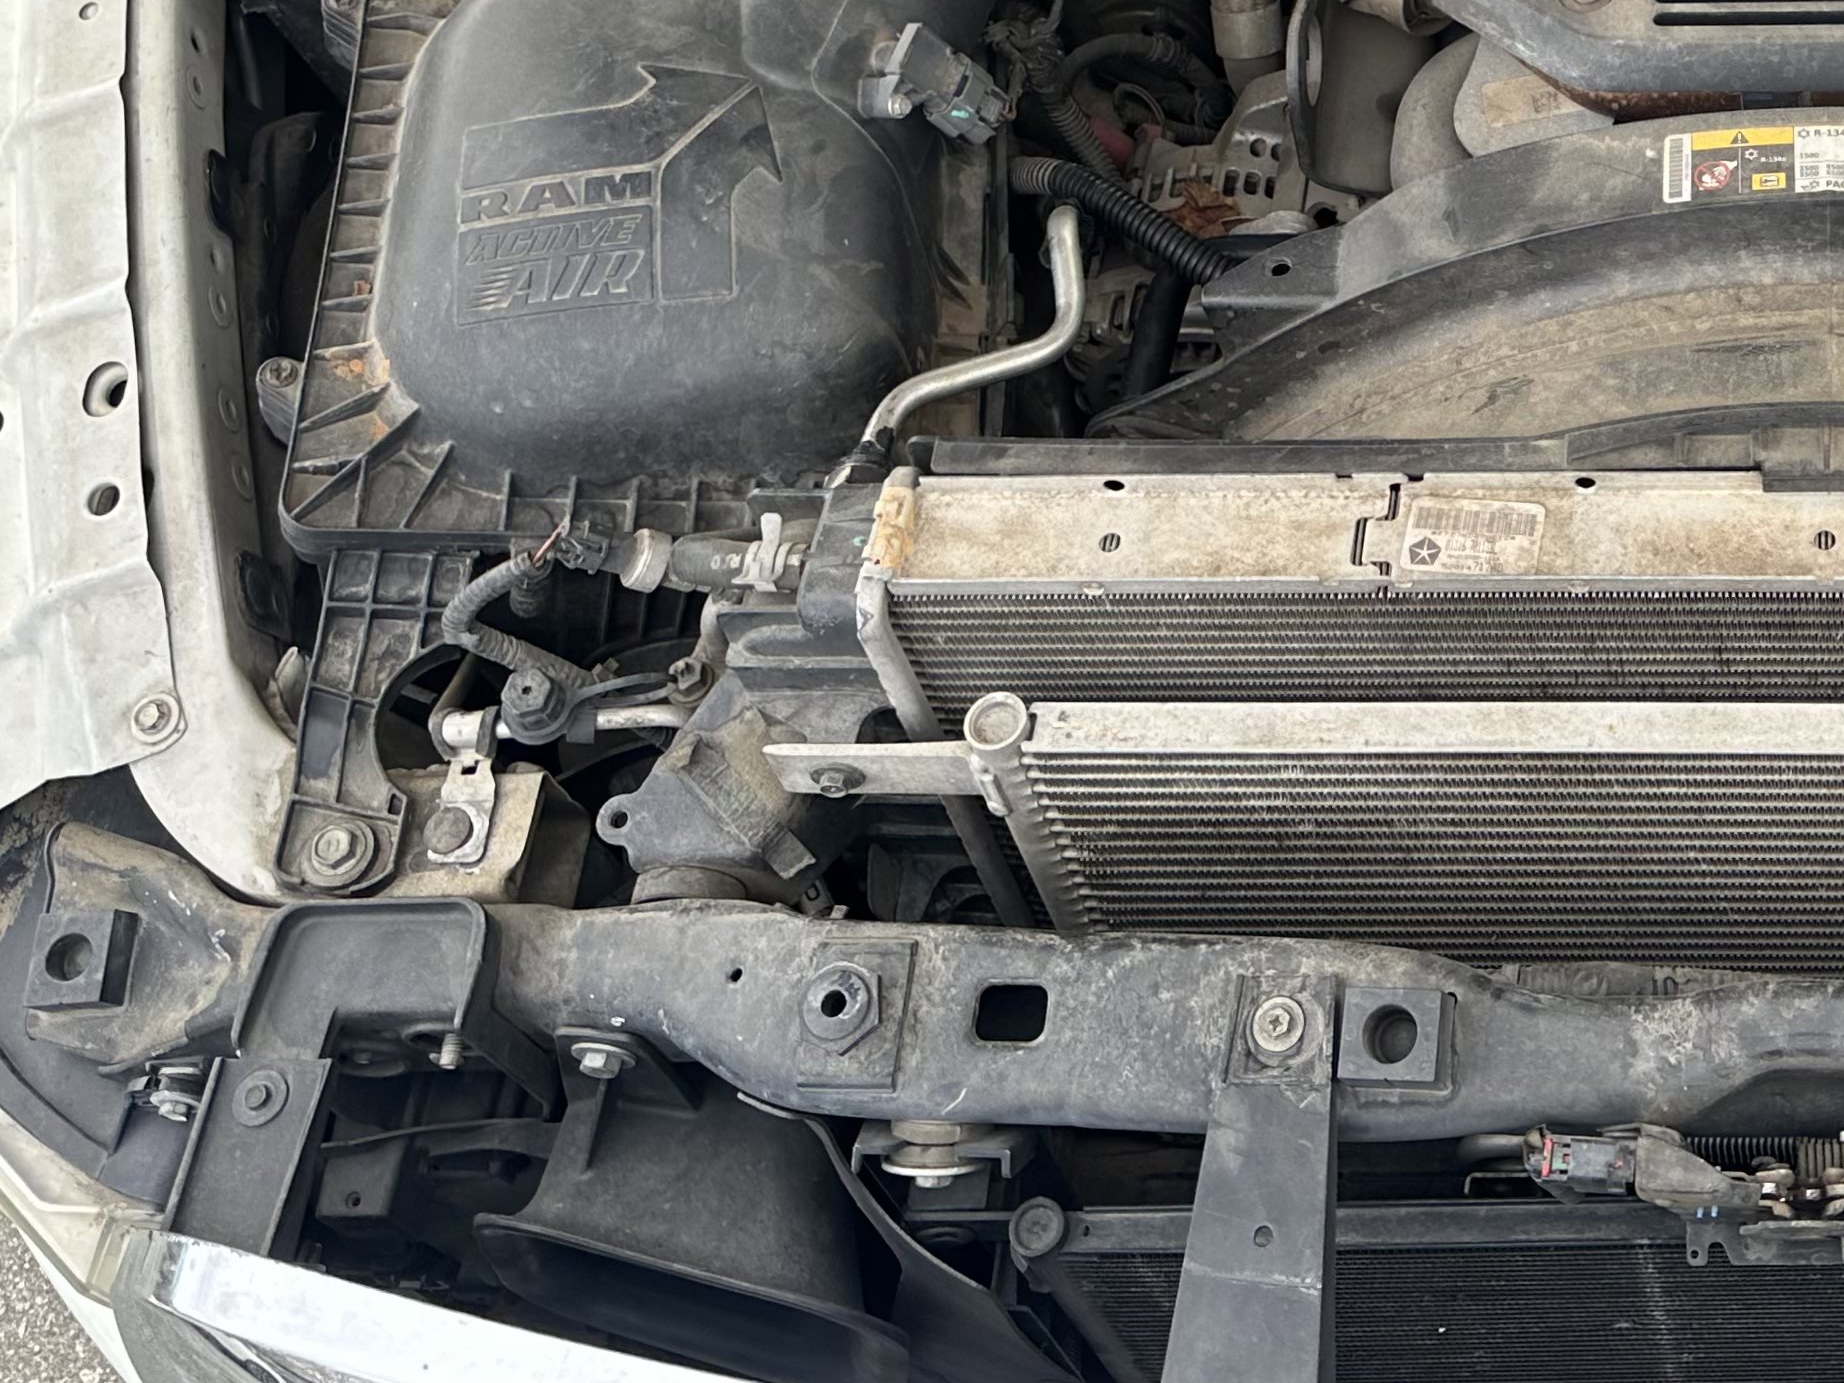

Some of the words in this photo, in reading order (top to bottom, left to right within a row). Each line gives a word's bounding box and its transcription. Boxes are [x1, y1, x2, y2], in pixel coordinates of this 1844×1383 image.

[459, 171, 651, 224] RAM
[465, 214, 642, 265] ACTIVE
[495, 249, 645, 309] AIR
